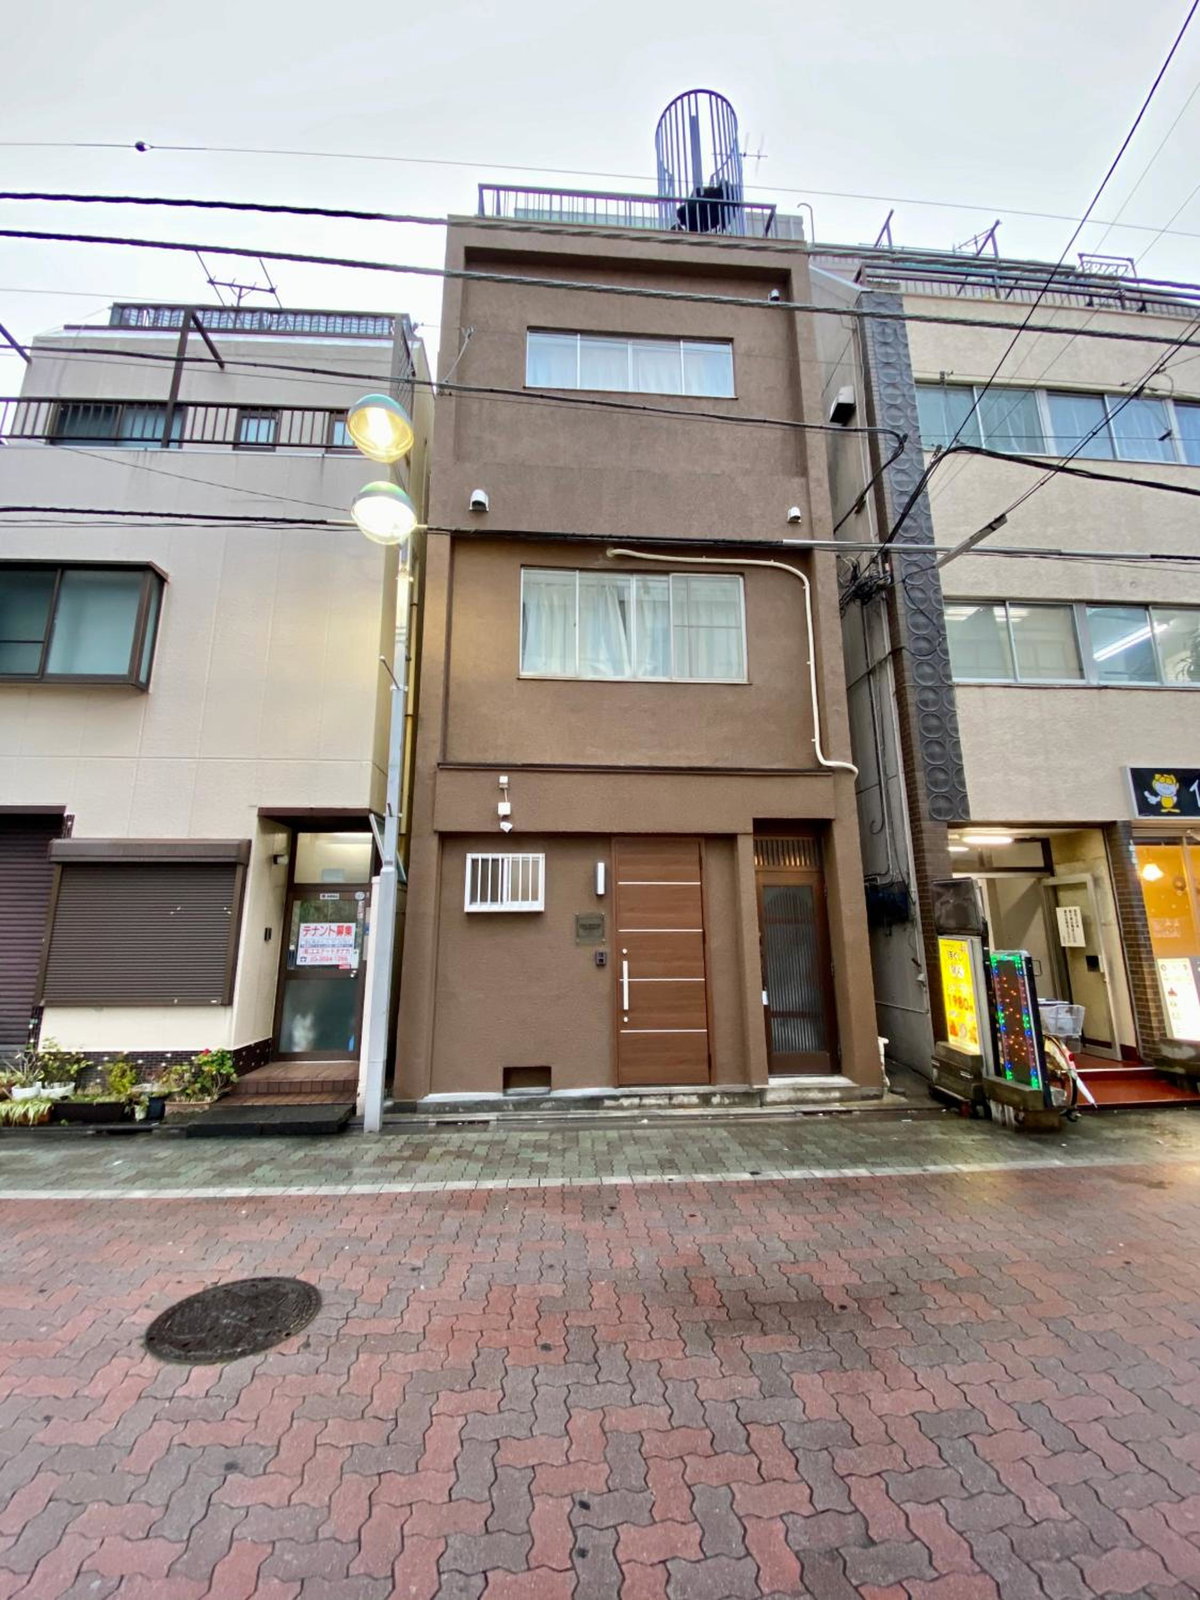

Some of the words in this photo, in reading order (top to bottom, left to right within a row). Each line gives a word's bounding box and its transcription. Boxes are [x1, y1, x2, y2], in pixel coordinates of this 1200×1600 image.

[303, 925, 352, 936] テナント募集
